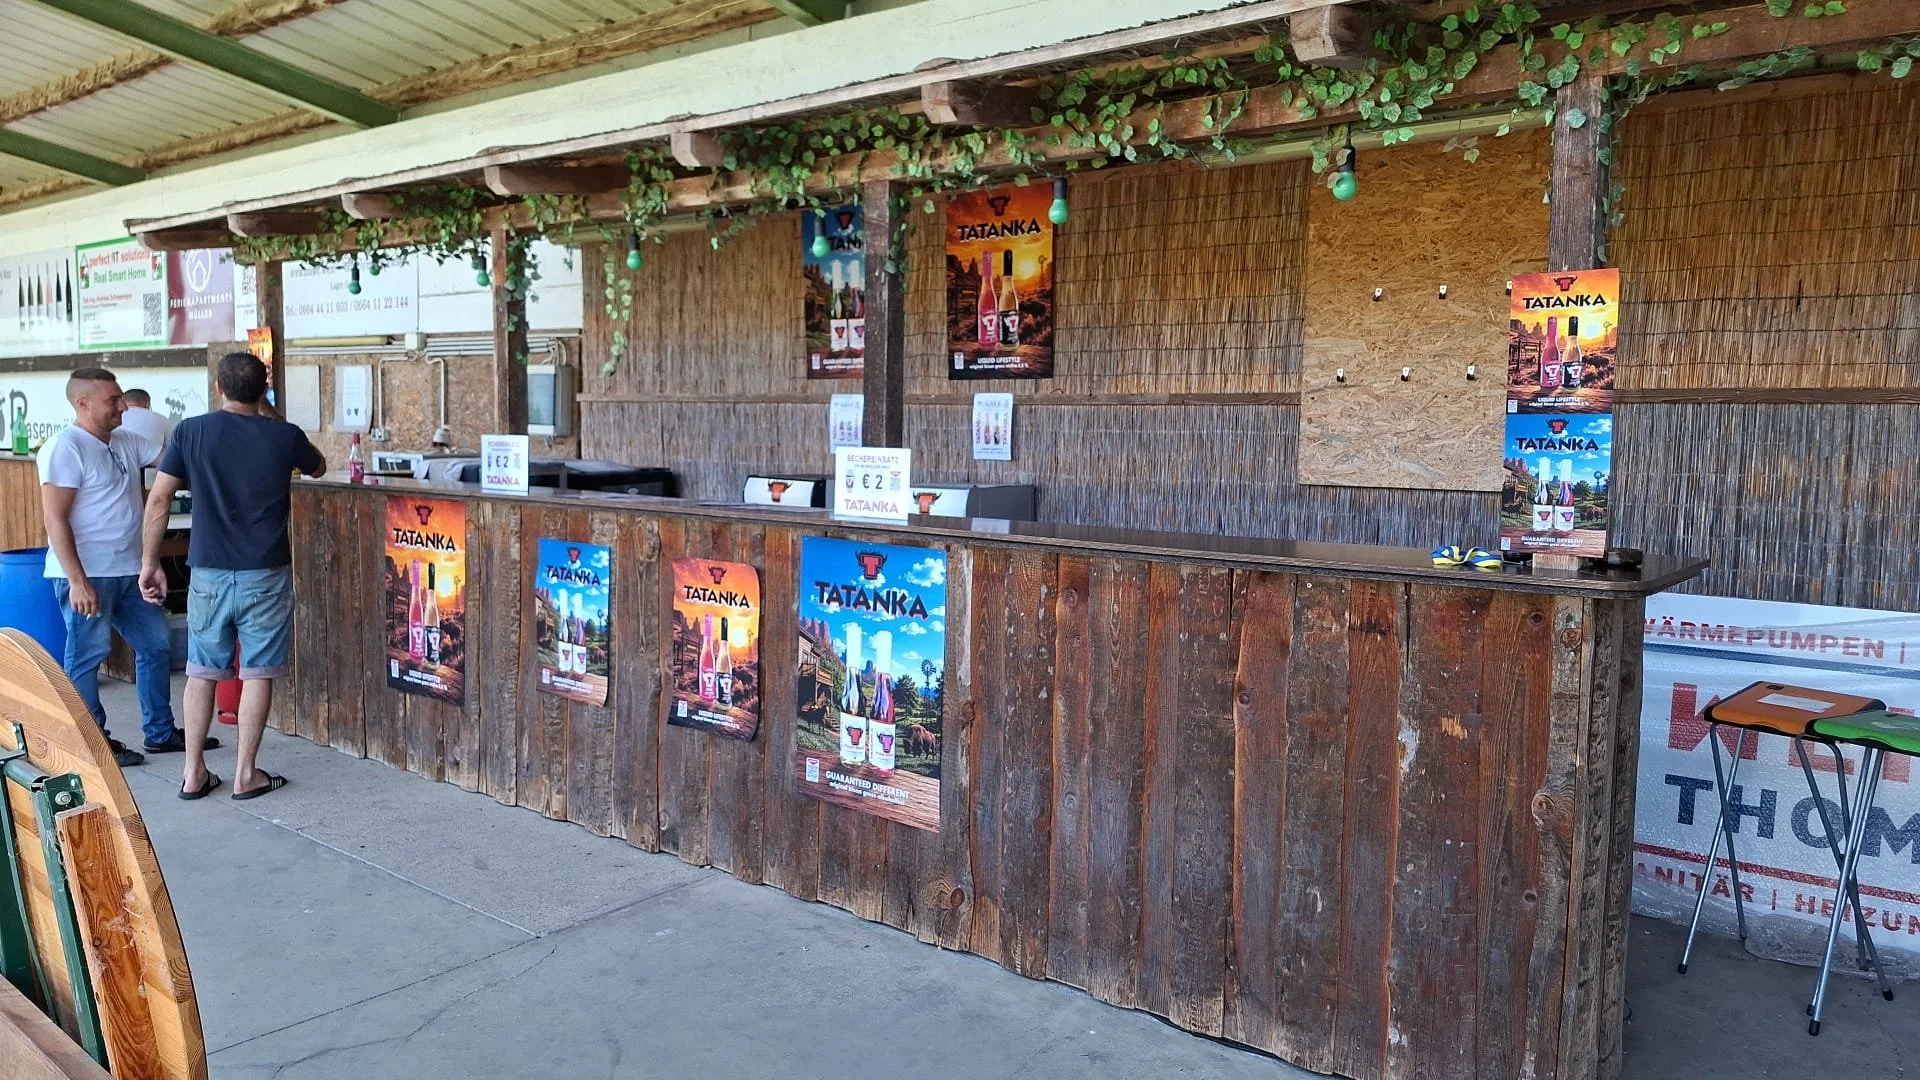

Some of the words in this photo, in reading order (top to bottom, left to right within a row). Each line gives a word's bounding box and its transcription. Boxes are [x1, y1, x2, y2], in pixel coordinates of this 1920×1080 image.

[957, 217, 1041, 242] TATANKA
[93, 271, 107, 284] Real
[108, 269, 127, 282] Smart
[128, 267, 147, 280] Home
[384, 297, 392, 309] 22
[1523, 294, 1607, 310] TATANKA
[1516, 437, 1600, 451] TATANKA
[503, 455, 509, 468] 2
[487, 475, 521, 486] TATANKA
[862, 473, 870, 489] €
[875, 474, 883, 490] 2
[844, 499, 899, 514] TATANKA
[393, 527, 456, 552] TATANKA
[546, 564, 602, 586] TATANKA
[683, 585, 751, 609] TATANKA
[814, 581, 929, 621] TATANKA
[826, 771, 872, 790] GUARANTEED
[872, 782, 910, 800] DIFFERENT
[1664, 774, 1920, 866] THOM
[1635, 862, 1755, 904] ANITÄR
